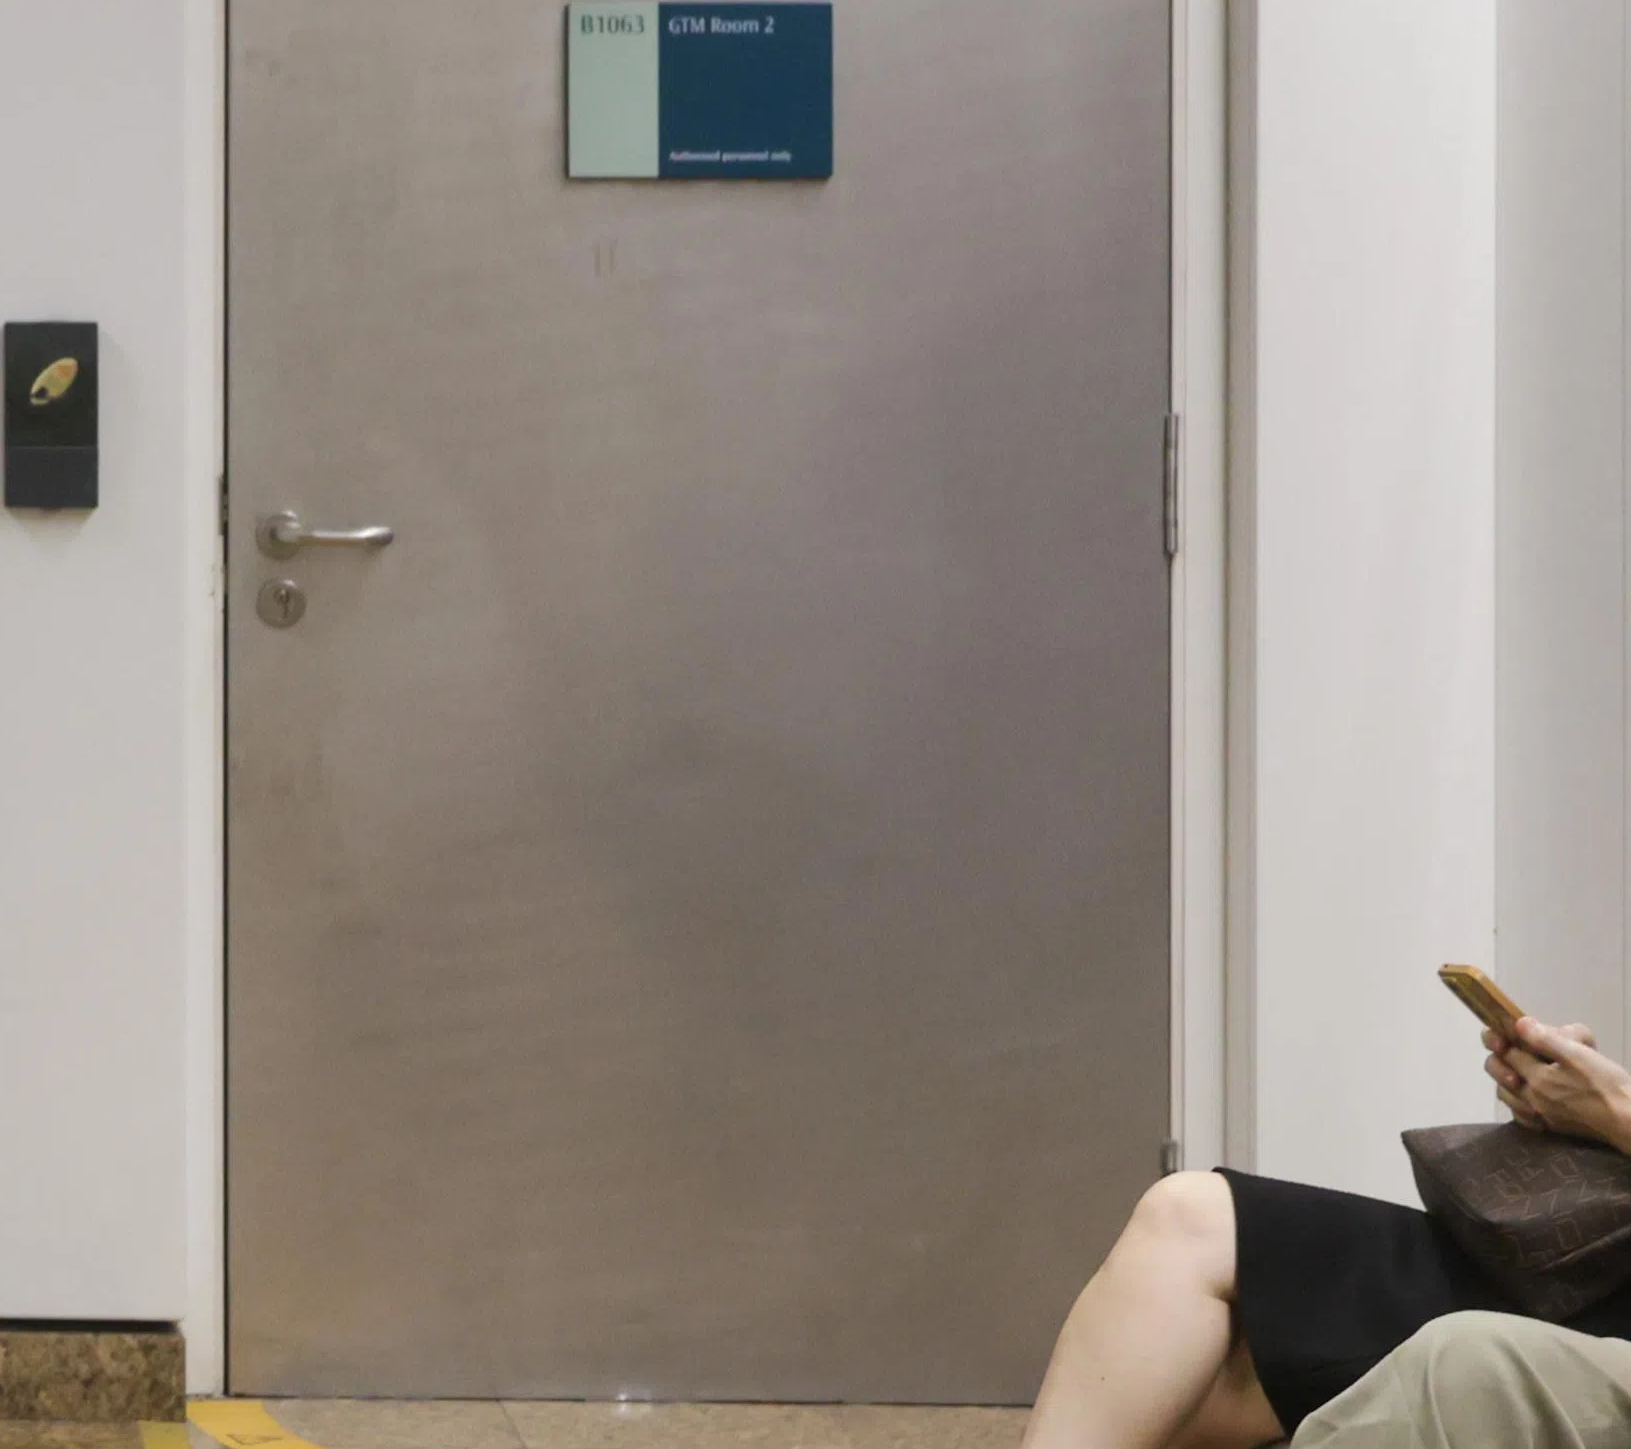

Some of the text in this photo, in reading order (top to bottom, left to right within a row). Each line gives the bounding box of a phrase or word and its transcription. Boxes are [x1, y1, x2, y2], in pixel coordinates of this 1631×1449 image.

[580, 14, 645, 34] B1063
[711, 16, 759, 34] Room
[764, 15, 775, 34] 2
